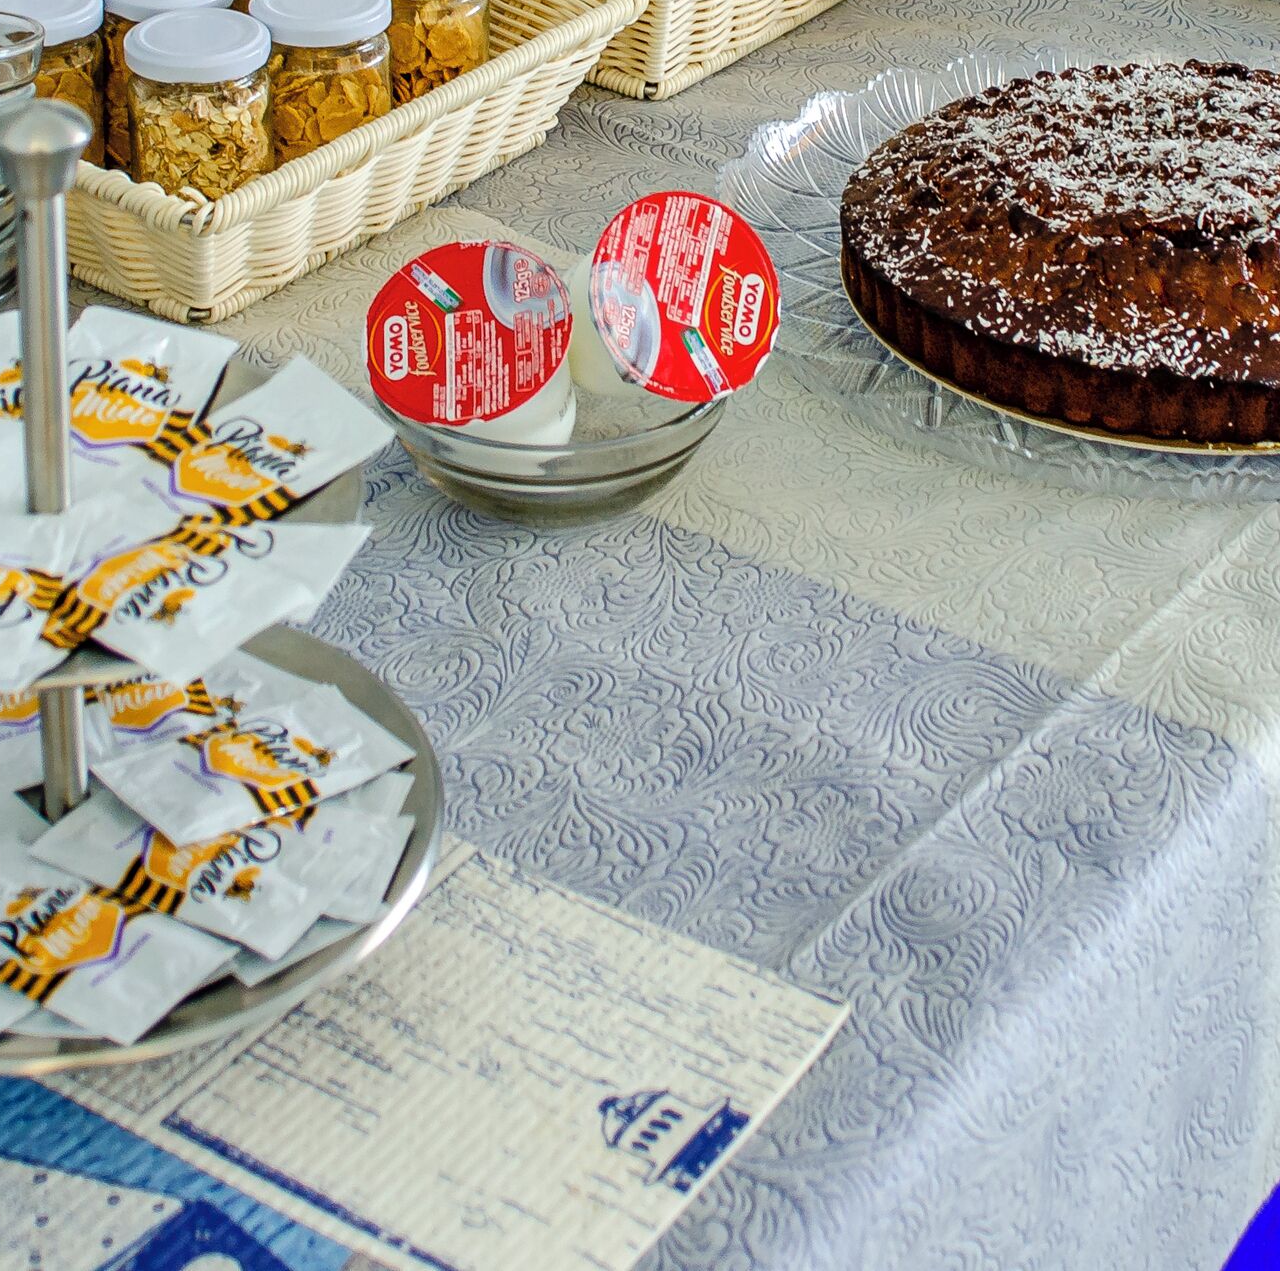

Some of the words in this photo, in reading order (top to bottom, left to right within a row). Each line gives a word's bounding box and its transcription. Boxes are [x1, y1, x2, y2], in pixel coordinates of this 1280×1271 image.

[404, 300, 438, 377] foodservice
[718, 263, 743, 357] foodservice
[738, 281, 761, 338] YOMO
[389, 322, 404, 375] YOMO
[69, 357, 181, 408] Piana
[215, 415, 300, 484] Piana
